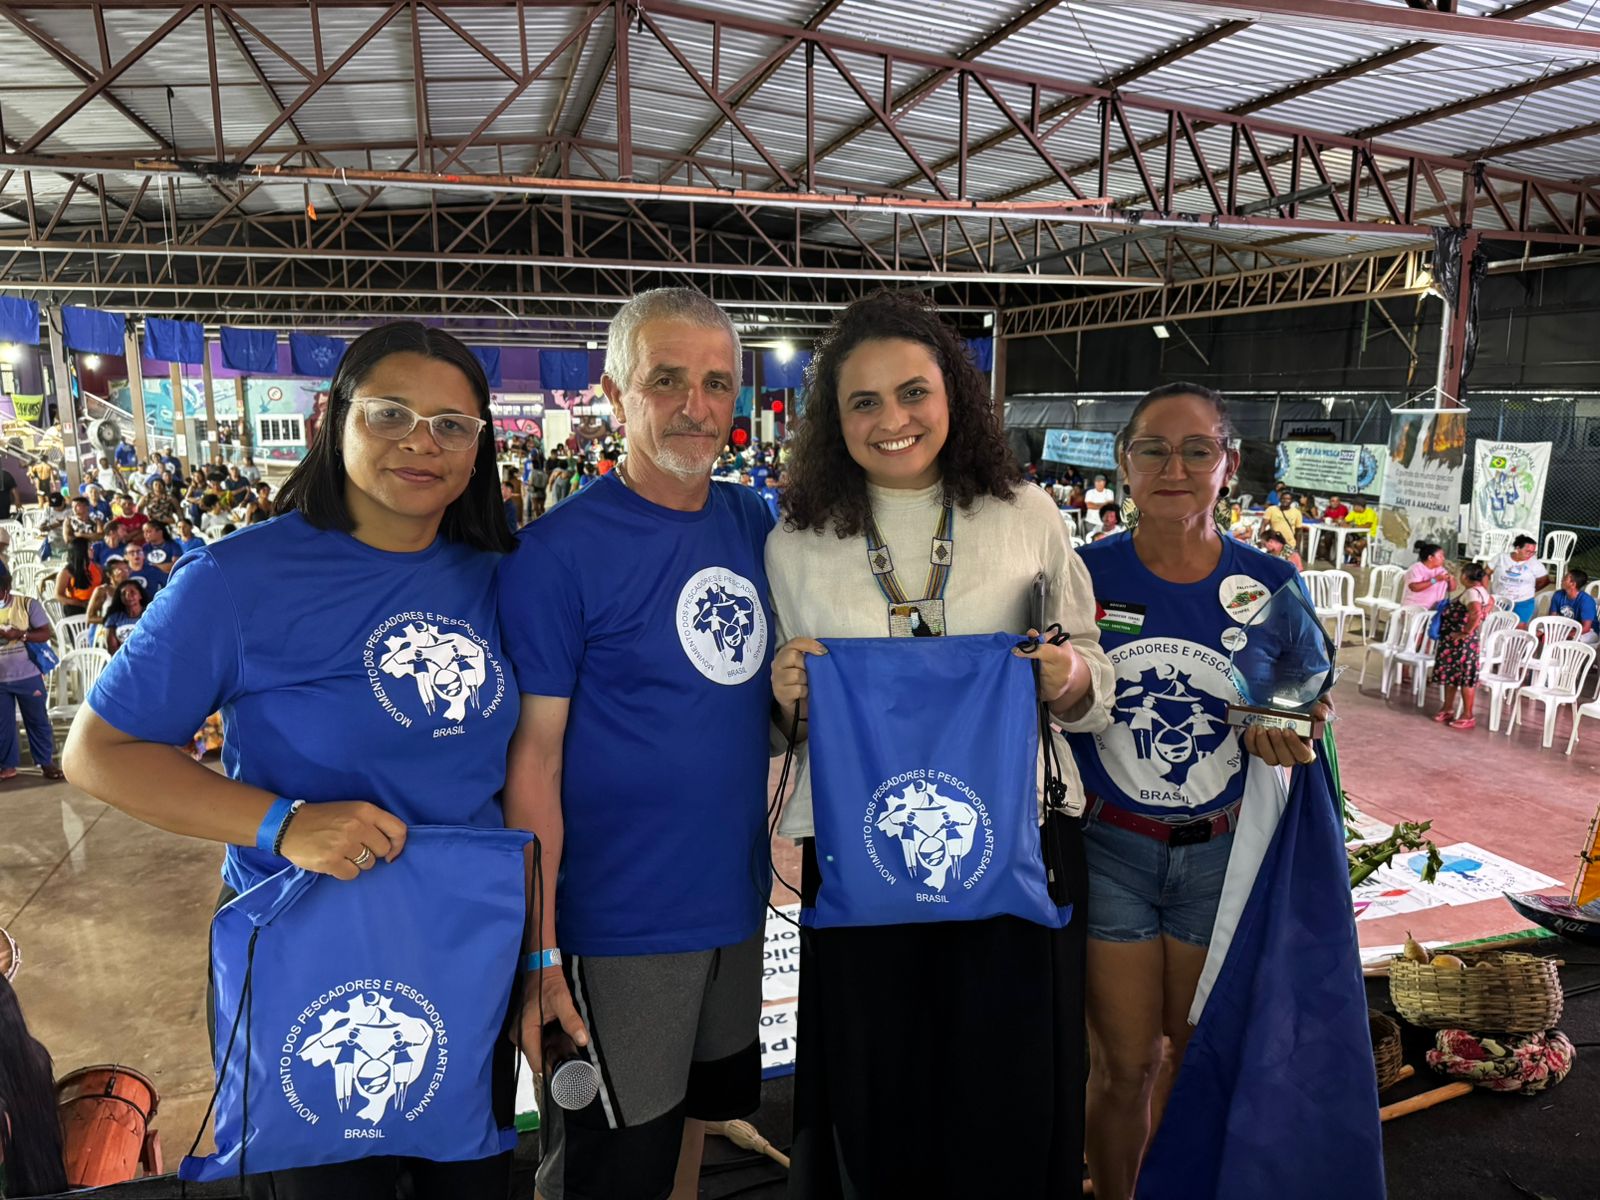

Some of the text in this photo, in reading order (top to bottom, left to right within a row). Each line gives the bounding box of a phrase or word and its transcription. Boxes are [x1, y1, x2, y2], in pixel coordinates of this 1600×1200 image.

[1396, 496, 1411, 506] SALVE
[684, 575, 717, 608] PESCADORES
[724, 576, 759, 613] PESCADORAS
[365, 611, 424, 649] PESCADORES
[436, 614, 493, 659] PESCADORAS
[753, 613, 765, 660] ARTESANAIS
[363, 650, 375, 668] DOS
[684, 630, 715, 671] MOVIMENTO
[1112, 643, 1178, 665] SCADORES
[1182, 646, 1190, 656] E
[483, 660, 505, 719] ARTESANAIS
[727, 667, 747, 677] BRASIL
[368, 669, 412, 728] MOVIMENTO
[433, 725, 466, 738] BRASIL
[1140, 789, 1192, 805] BRASIL
[863, 769, 994, 889] MOVIMENTO DOS PESCADORES E PESCADORAS ARTESANAIS
[916, 893, 949, 903] BRASIL
[280, 979, 448, 1125] MOVIMENTO DOS PESCADORES E PESCADORAS ARTESANAIS
[344, 1129, 385, 1139] BRASIL
